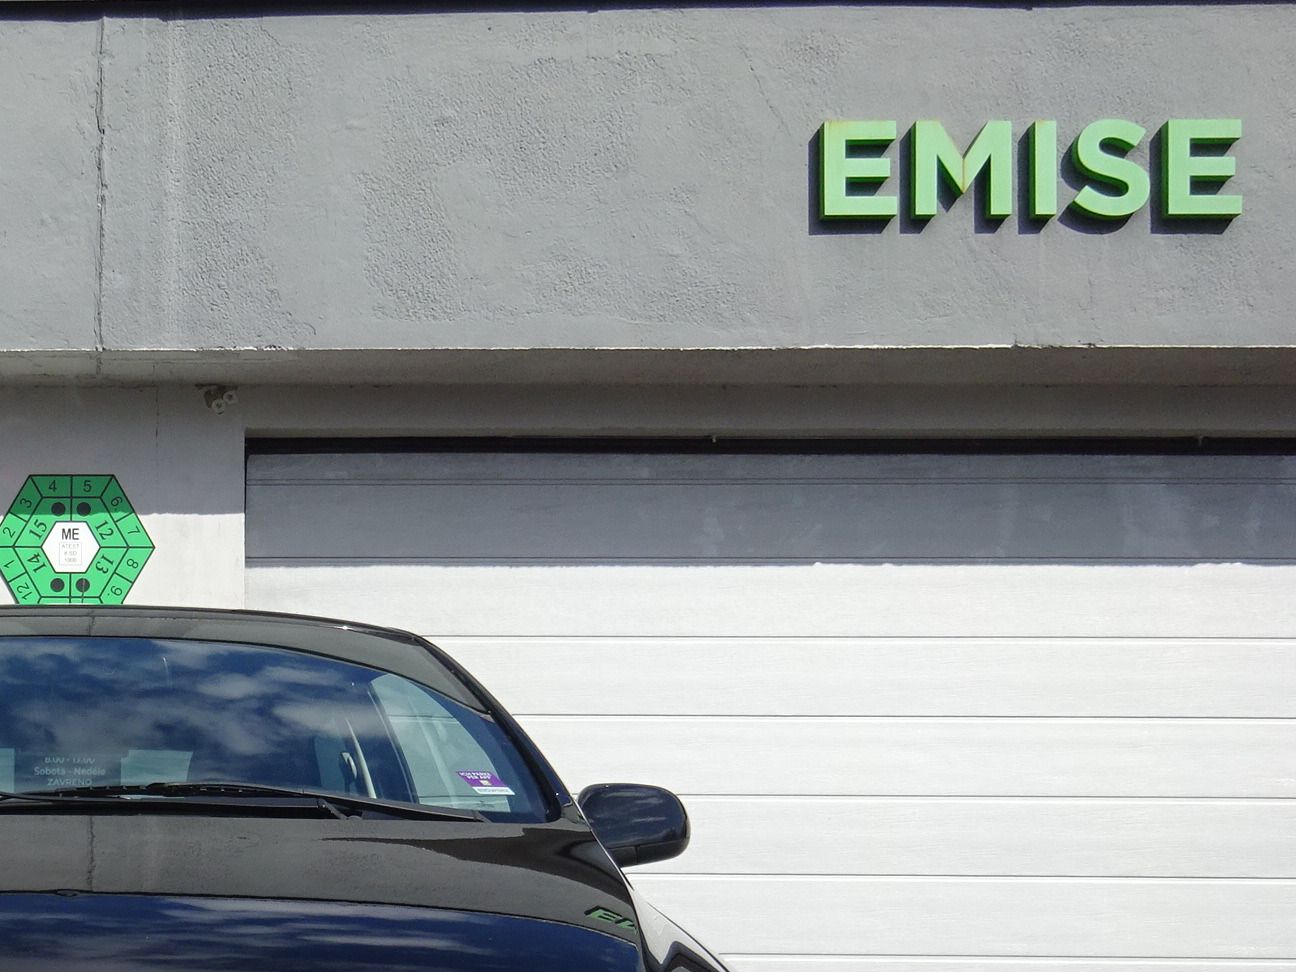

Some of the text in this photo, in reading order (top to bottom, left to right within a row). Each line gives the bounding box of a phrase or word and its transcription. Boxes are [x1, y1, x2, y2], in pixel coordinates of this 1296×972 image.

[819, 119, 1242, 220] EMISE
[48, 480, 57, 492] 4
[83, 480, 92, 492] 5
[19, 498, 32, 509] 3
[2, 526, 16, 538] 2
[28, 519, 48, 540] 15
[61, 528, 80, 540] ME
[95, 520, 114, 540] 12
[127, 525, 140, 535] 7
[3, 559, 15, 569] 1
[27, 552, 47, 573] 14
[95, 554, 115, 575] 13
[126, 558, 139, 569] 8
[16, 582, 33, 601] 12
